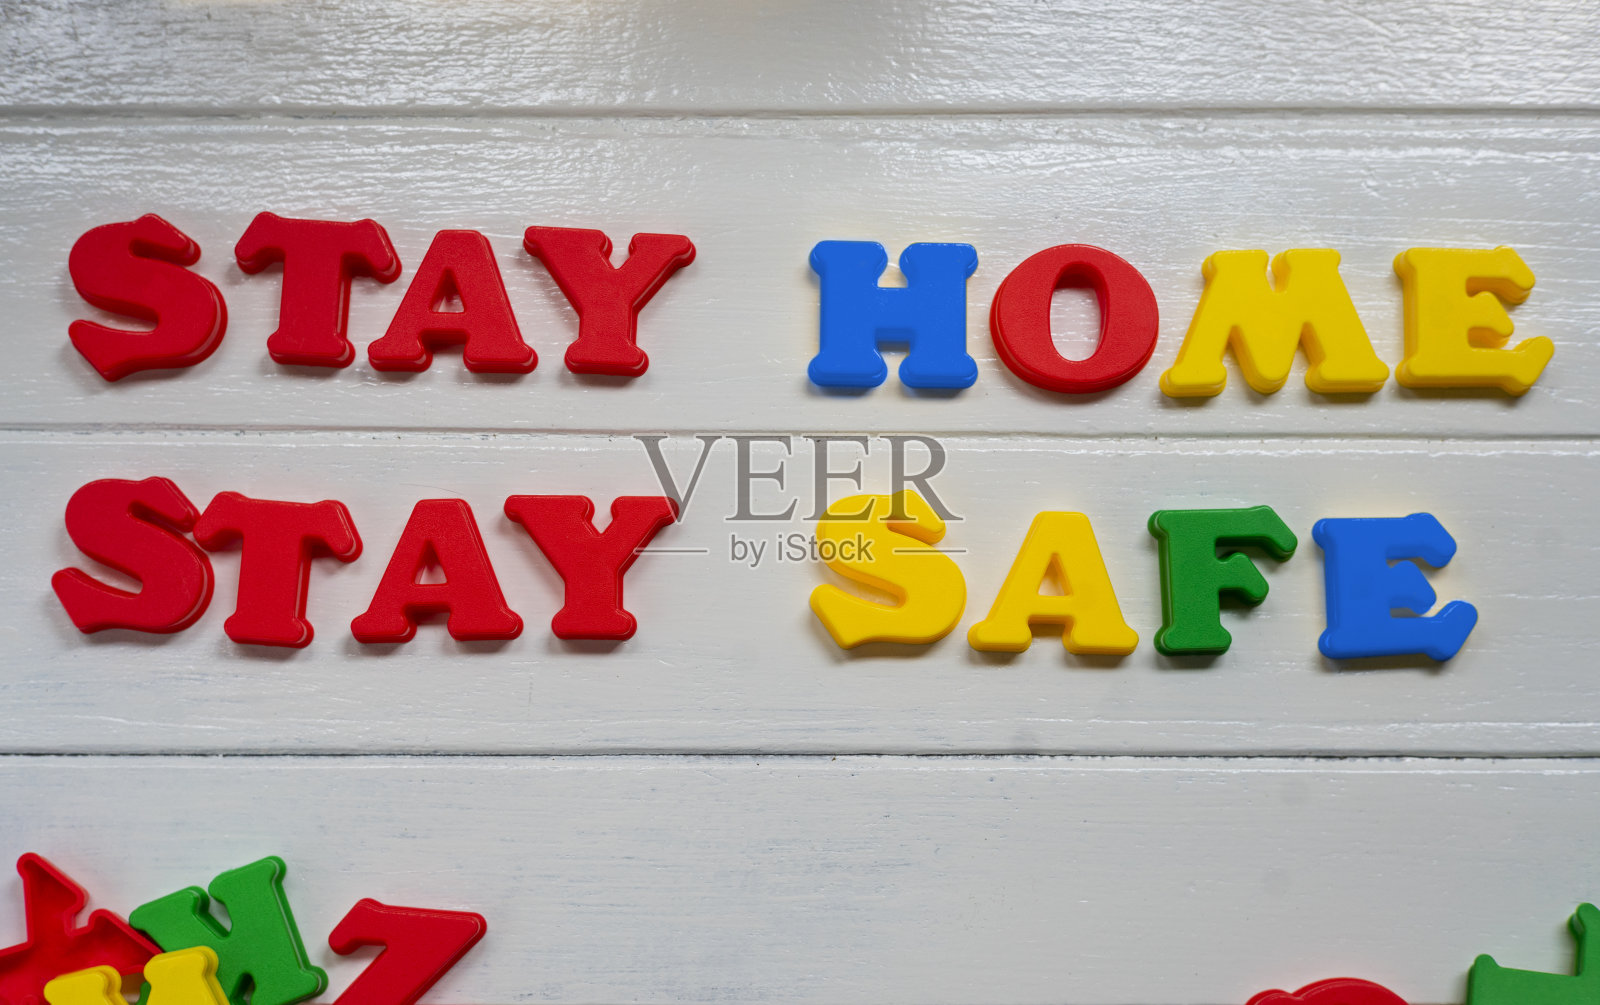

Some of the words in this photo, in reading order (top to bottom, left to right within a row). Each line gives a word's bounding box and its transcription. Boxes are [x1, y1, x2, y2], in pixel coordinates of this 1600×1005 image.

[68, 212, 697, 383] STAY
[807, 240, 1556, 400] HOME
[50, 476, 678, 649] STAY
[809, 488, 1479, 660] SAFE
